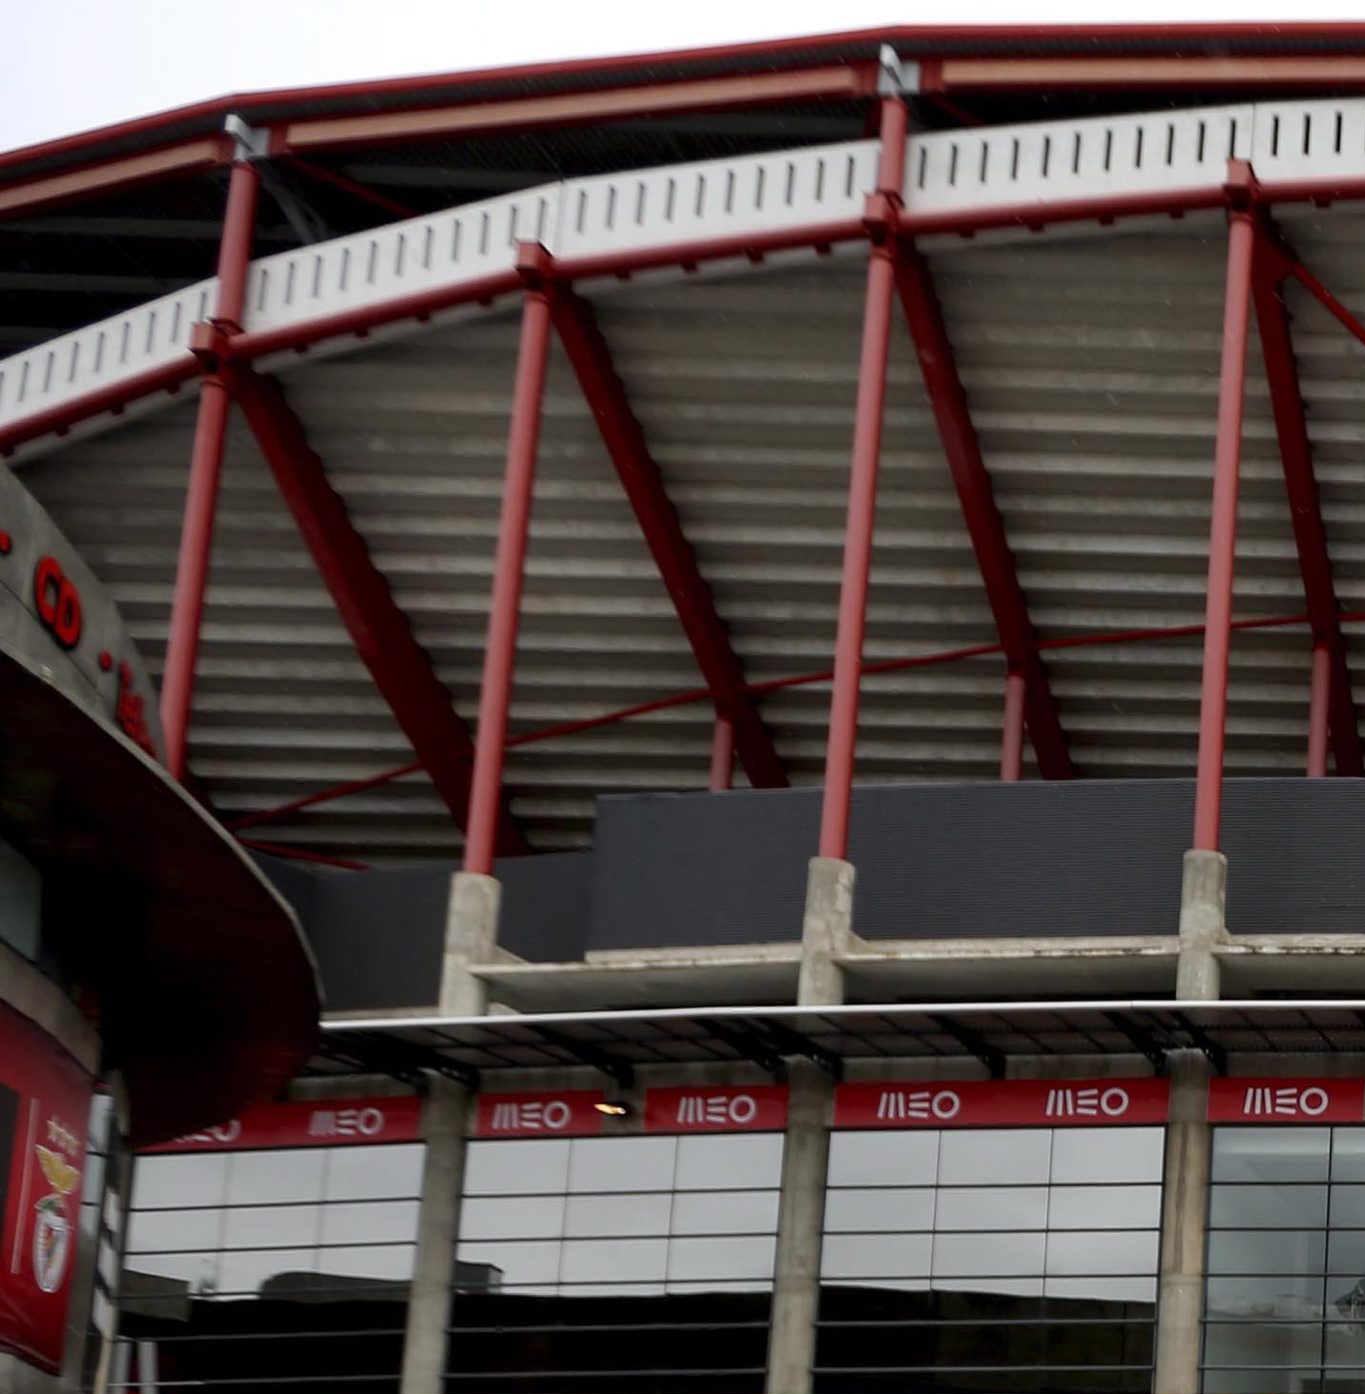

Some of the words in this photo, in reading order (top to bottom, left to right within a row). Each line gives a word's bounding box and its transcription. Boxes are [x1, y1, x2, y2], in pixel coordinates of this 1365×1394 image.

[678, 1094, 757, 1125] MEO
[877, 1091, 960, 1120] MEO
[1045, 1087, 1130, 1117] MEO
[1243, 1086, 1329, 1115] MEO
[309, 1107, 385, 1138] MEO
[492, 1102, 571, 1131] MEO
